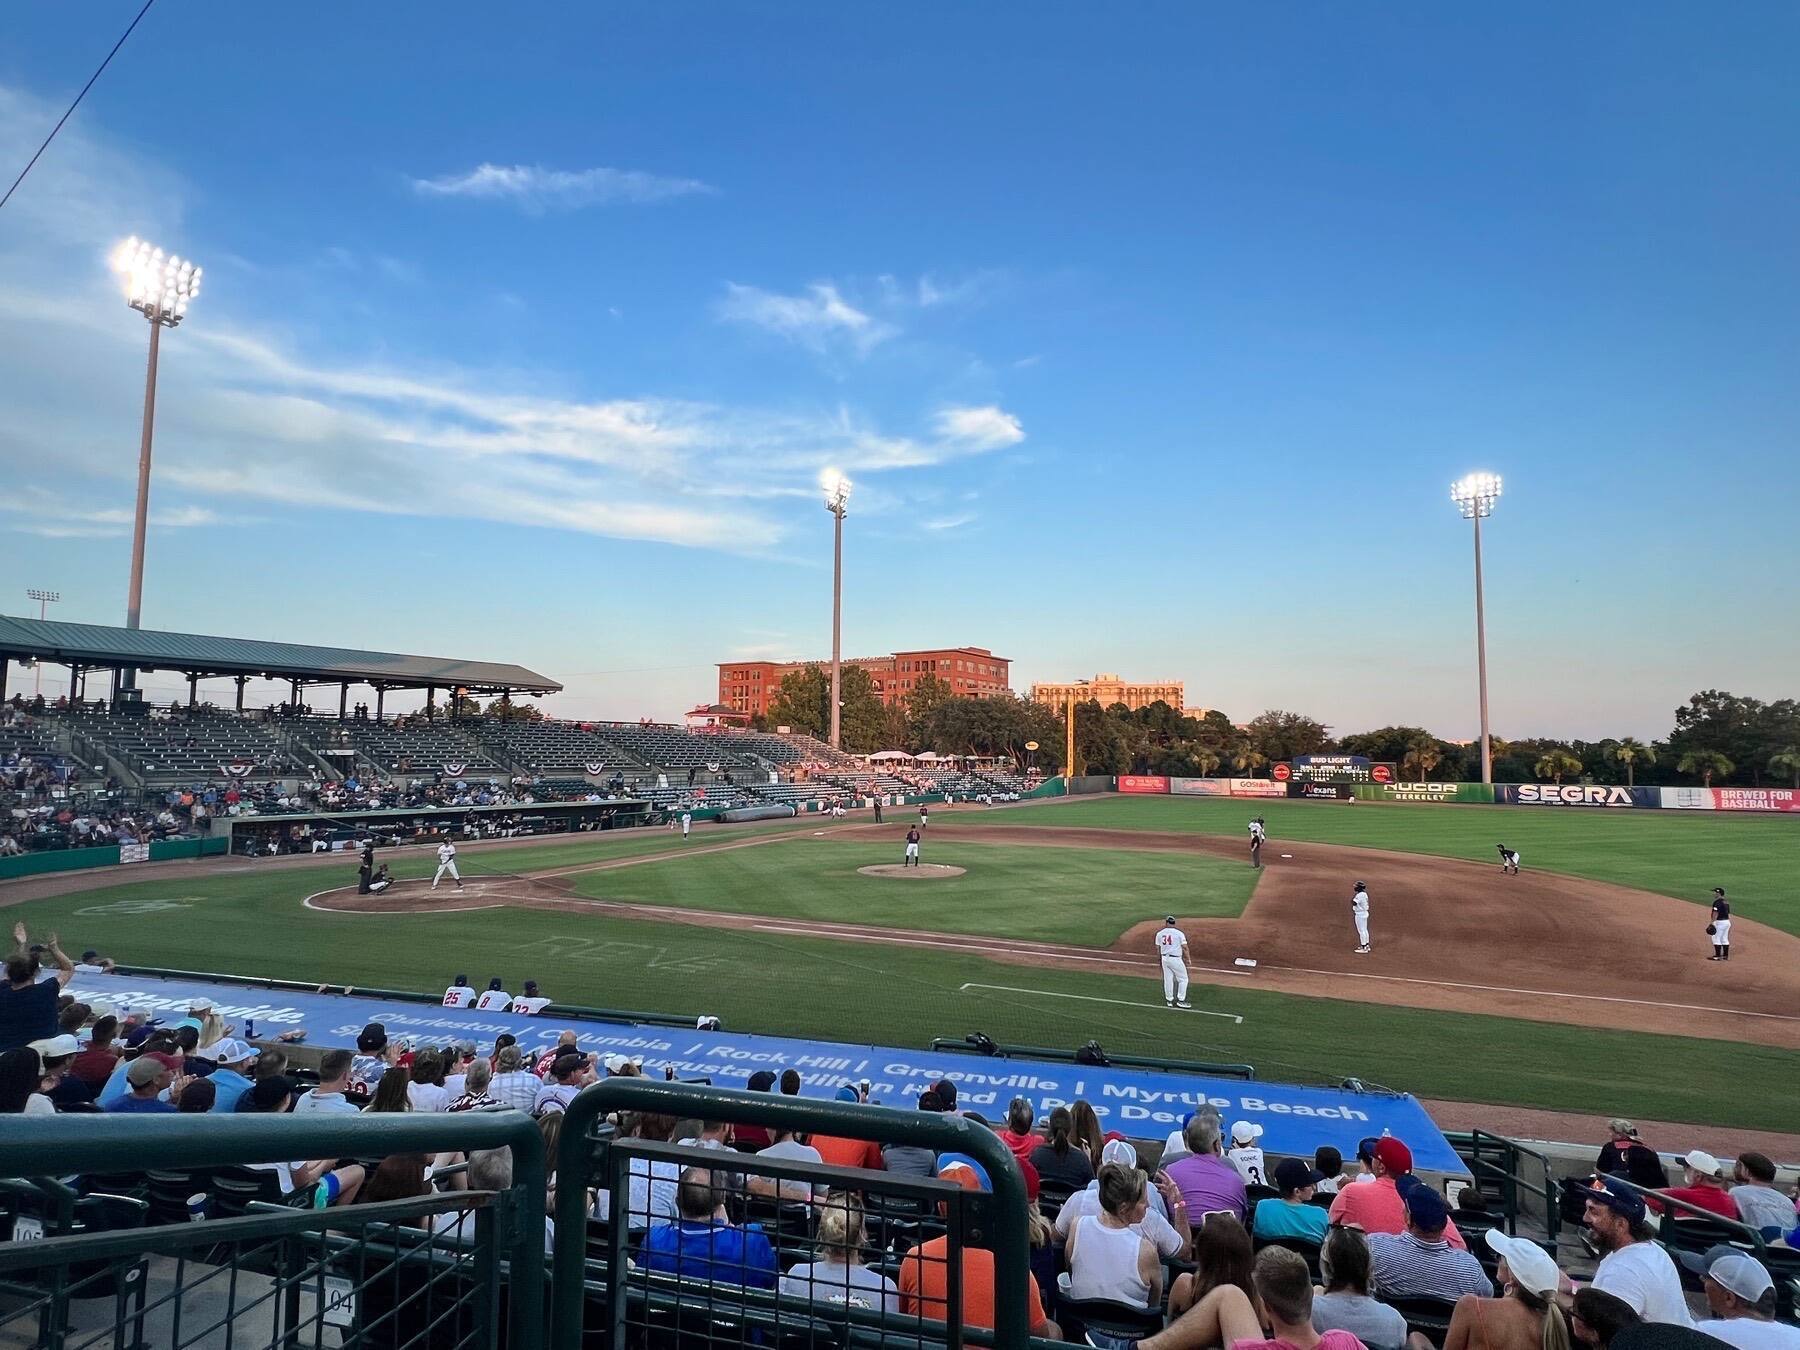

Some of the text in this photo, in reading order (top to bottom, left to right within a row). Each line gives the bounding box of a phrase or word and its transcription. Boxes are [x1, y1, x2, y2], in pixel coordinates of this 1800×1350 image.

[1301, 783, 1337, 794] Nexans
[1384, 782, 1458, 792] NUCOR
[1395, 793, 1445, 801] BERKELEY
[1518, 784, 1633, 803] SEGRA
[1721, 790, 1793, 800] BREWED FOR
[1162, 935, 1173, 946] 34
[445, 992, 461, 1005] 25
[368, 1013, 512, 1034] Charleston
[537, 1029, 672, 1051] Clumbia
[706, 1046, 792, 1064] Rock
[794, 1054, 851, 1072] Hill
[883, 1063, 1059, 1090] Greenville
[1102, 1083, 1232, 1109] Myrtle
[1240, 1096, 1370, 1122] Beach
[797, 1071, 895, 1094] Hiltn
[901, 1083, 997, 1105] Had
[1040, 1097, 1111, 1117] Pe
[1120, 1105, 1185, 1124] De
[1247, 1165, 1262, 1185] 3
